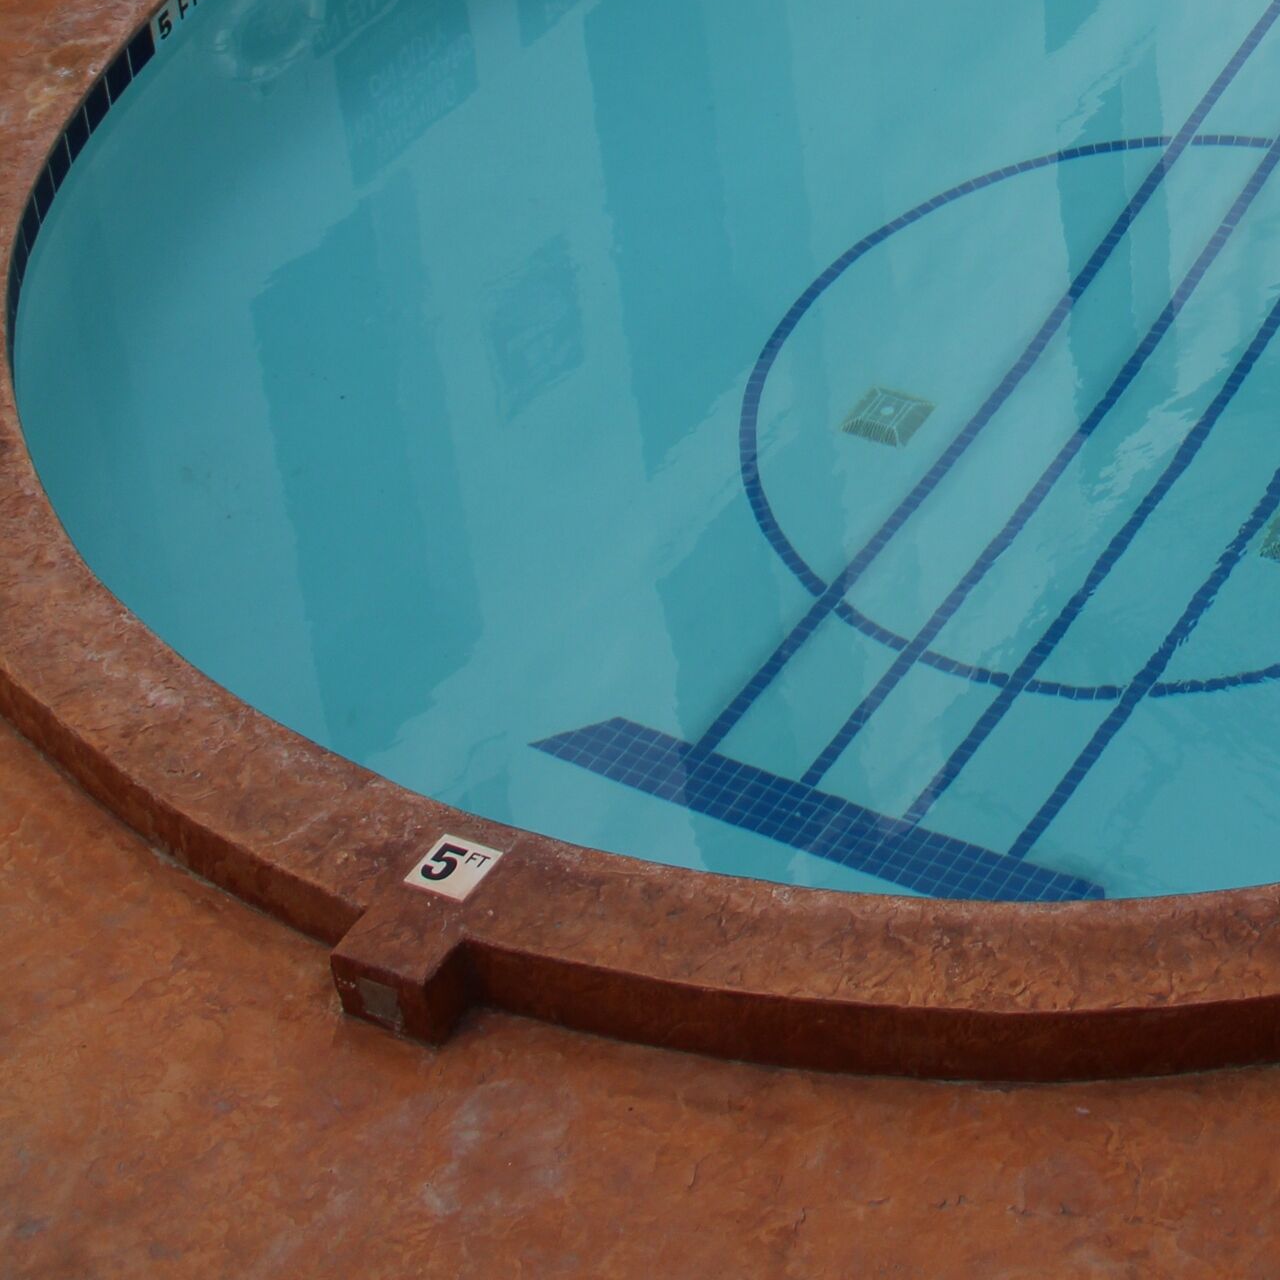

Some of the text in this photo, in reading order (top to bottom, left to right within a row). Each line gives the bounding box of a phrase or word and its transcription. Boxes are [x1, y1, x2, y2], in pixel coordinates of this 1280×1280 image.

[158, 10, 172, 40] 5
[421, 842, 491, 881] 5 FT
